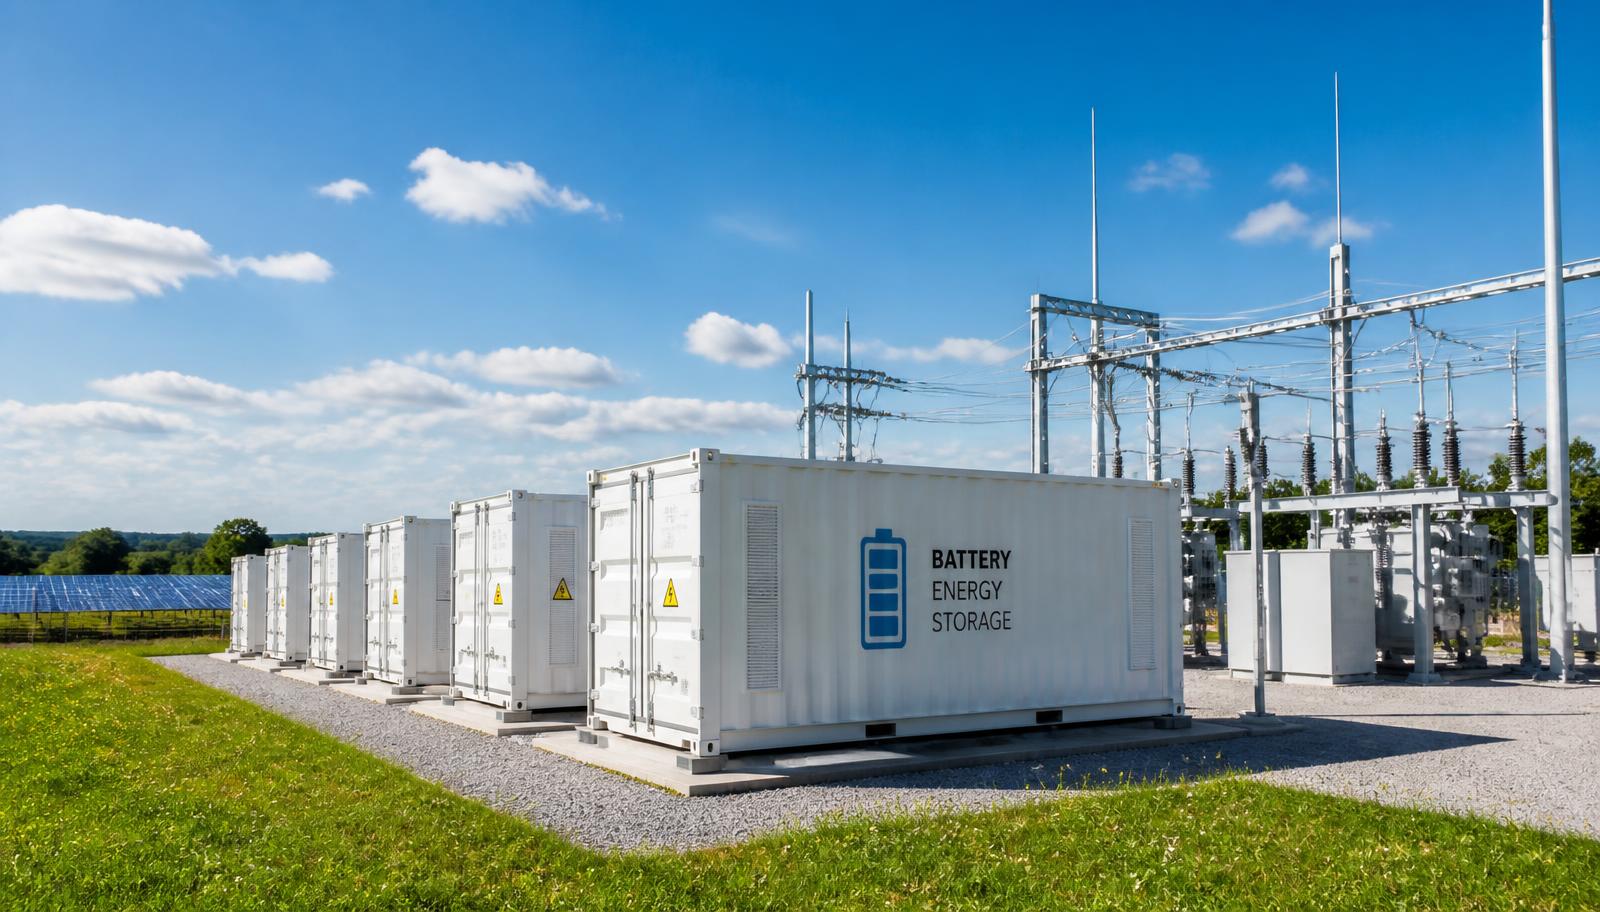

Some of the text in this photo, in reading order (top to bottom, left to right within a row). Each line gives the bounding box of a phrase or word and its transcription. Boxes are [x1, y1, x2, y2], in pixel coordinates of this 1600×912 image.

[932, 549, 1012, 570] BATTERY
[932, 580, 1003, 601] ENERGY
[932, 610, 1012, 633] STORAGE
